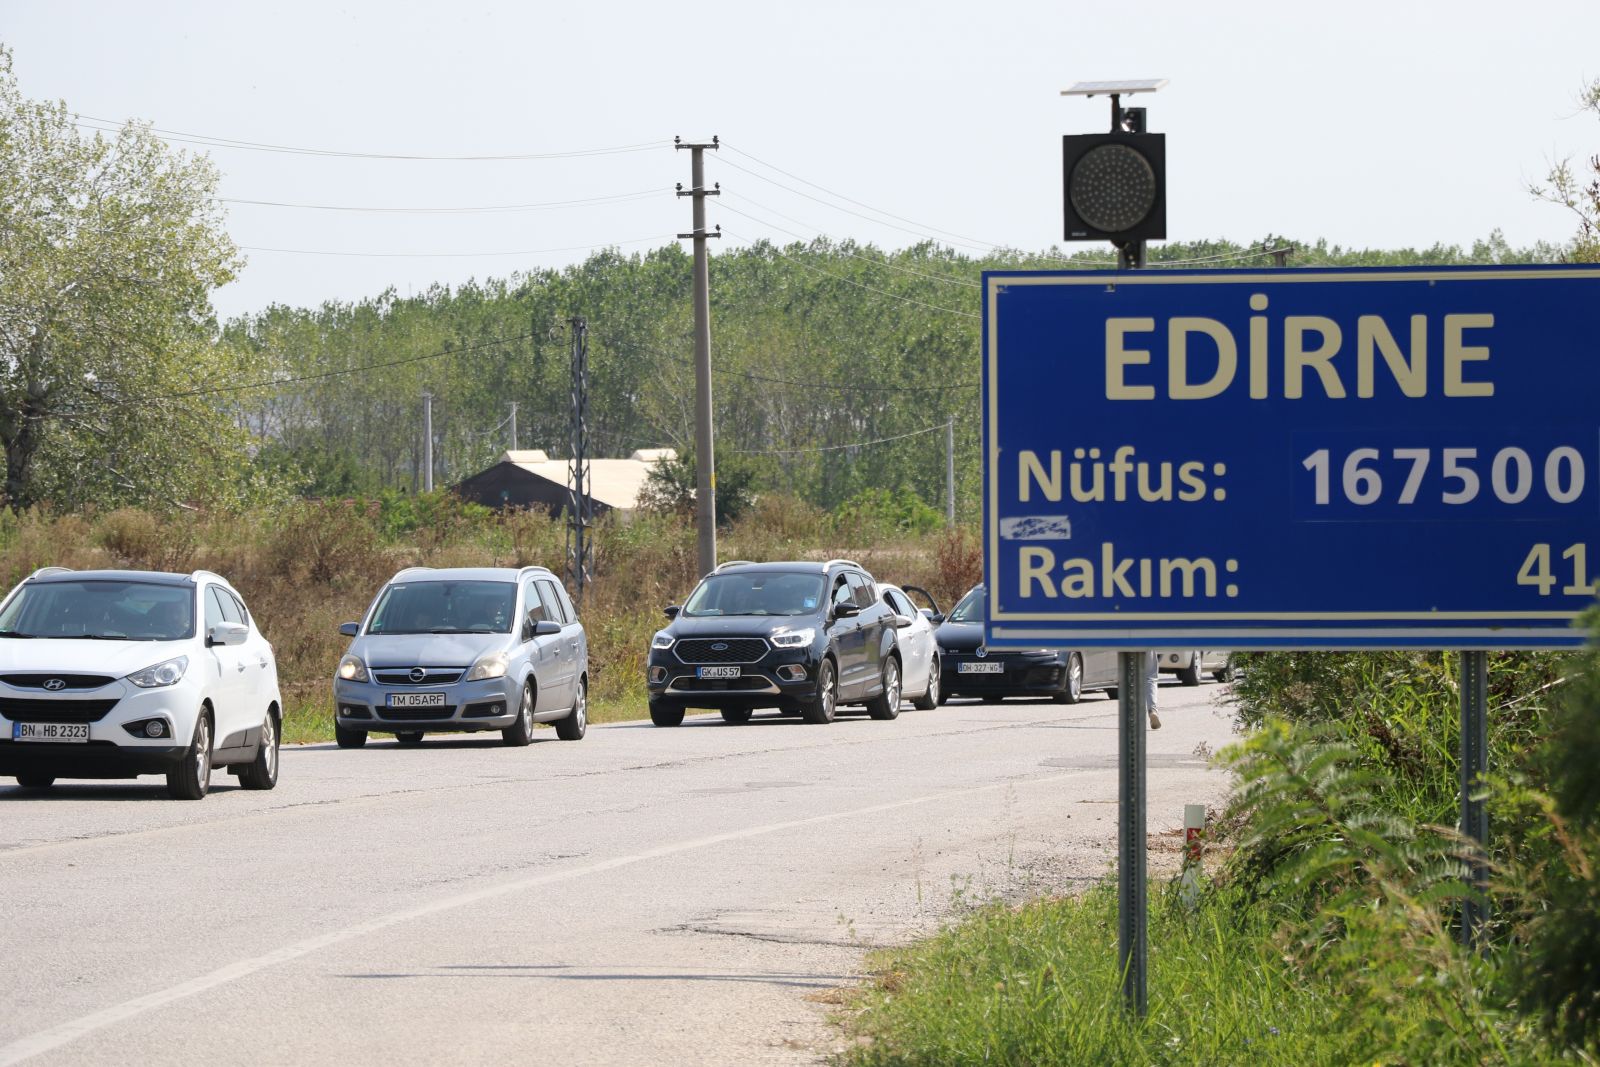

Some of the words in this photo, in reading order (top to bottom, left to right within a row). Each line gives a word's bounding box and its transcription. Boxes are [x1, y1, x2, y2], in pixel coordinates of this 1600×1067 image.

[1105, 293, 1495, 401] EDİRNE
[1018, 445, 1227, 503] Nüfus:
[1301, 446, 1586, 506] 167500
[1018, 541, 1240, 599] Rakım:
[1516, 543, 1597, 597] 41
[716, 667, 728, 676] US
[729, 667, 740, 676] 57
[392, 695, 406, 705] TM
[21, 724, 36, 737] BN
[43, 724, 58, 737] HB
[60, 725, 88, 737] 2323
